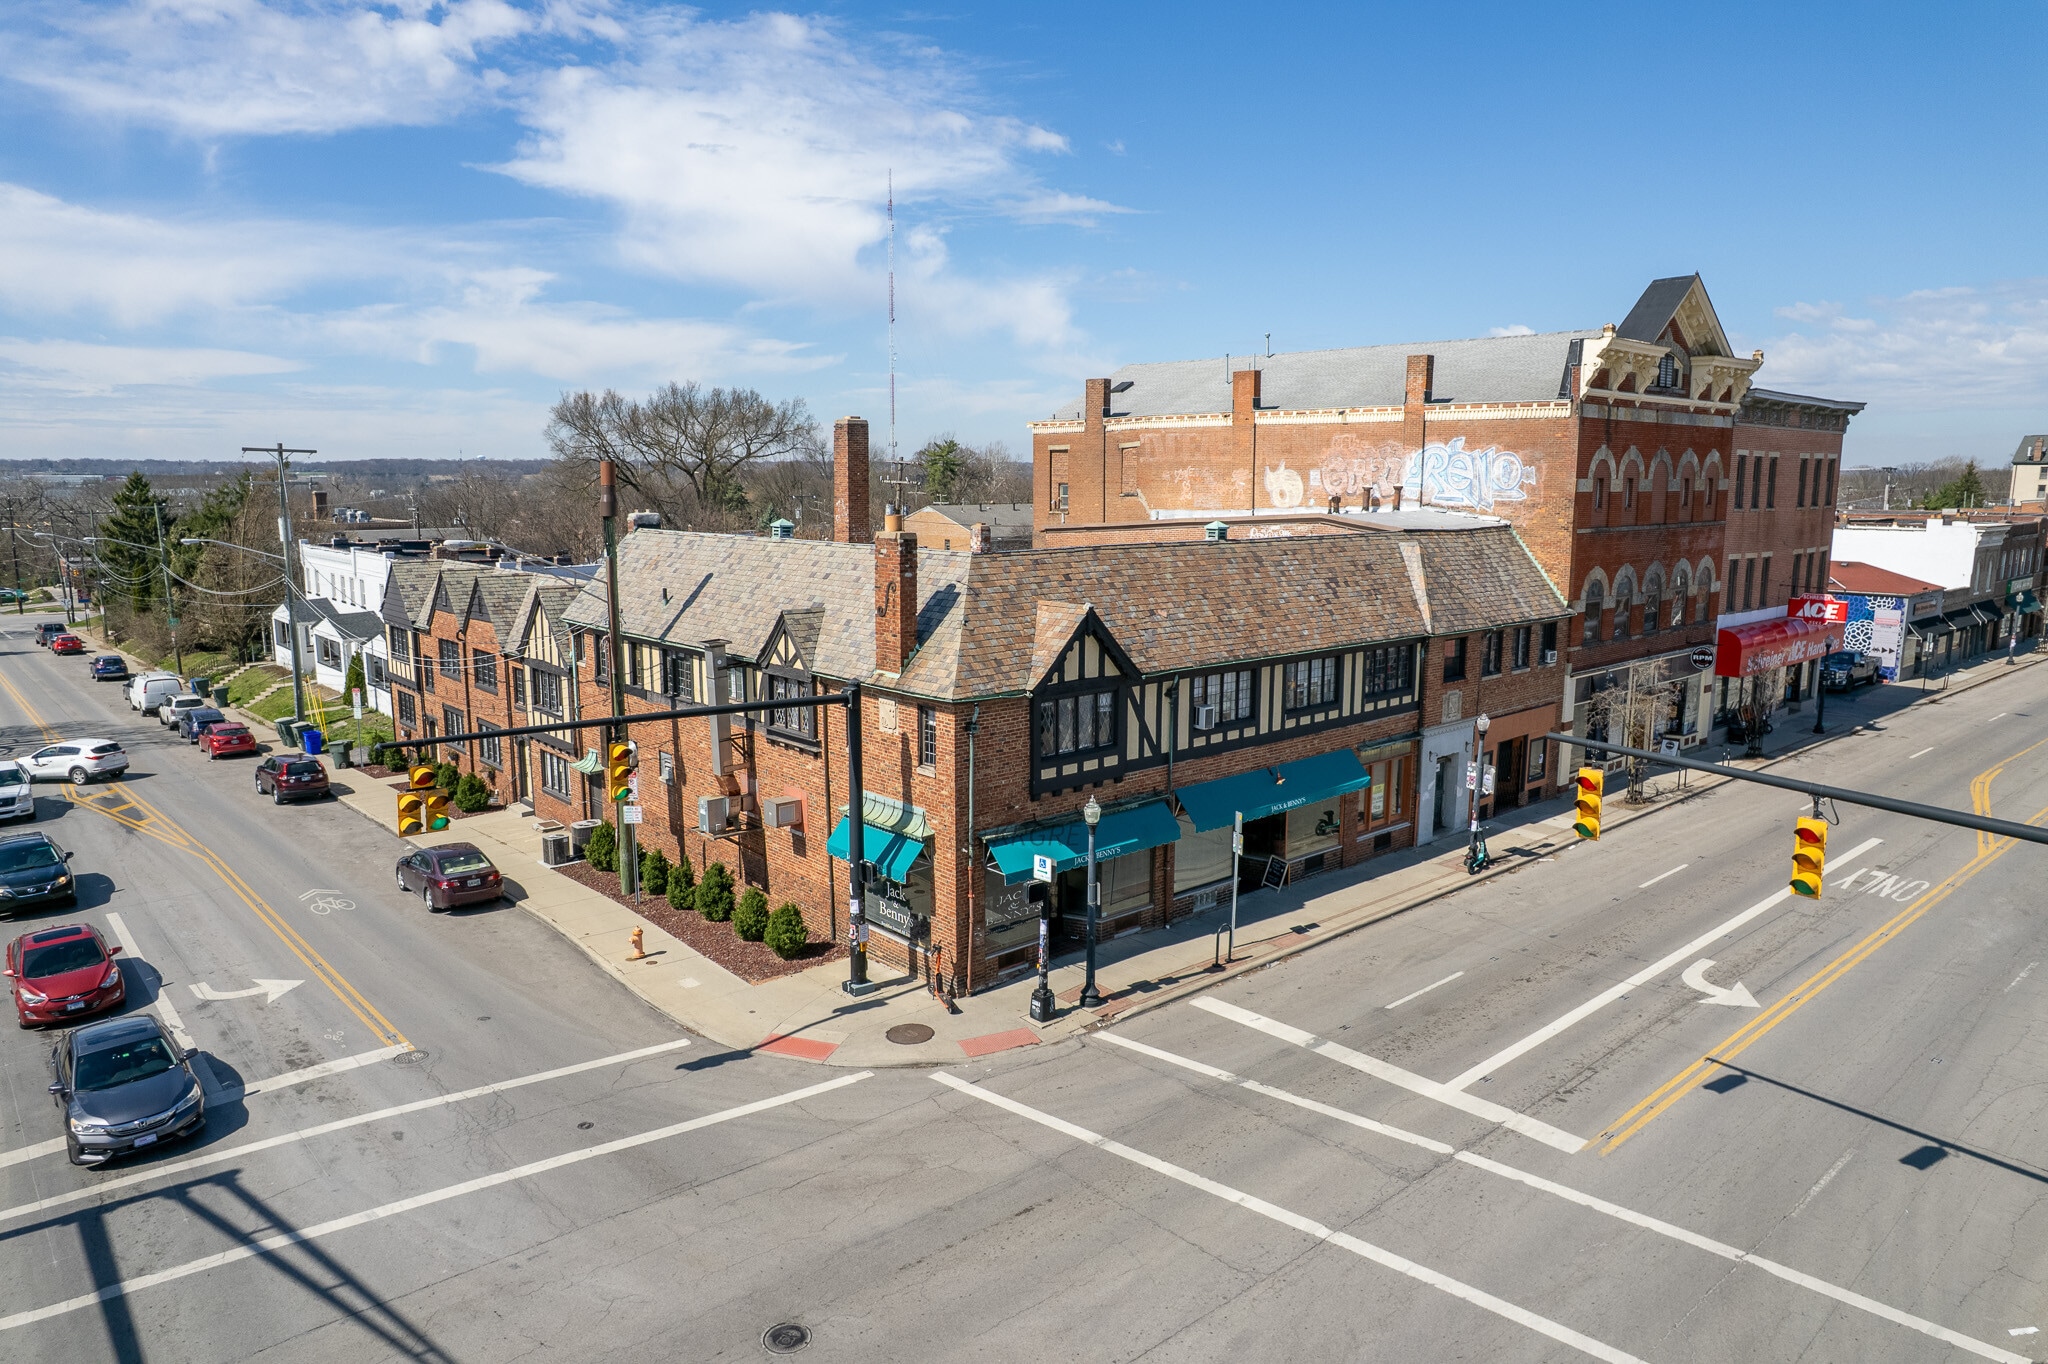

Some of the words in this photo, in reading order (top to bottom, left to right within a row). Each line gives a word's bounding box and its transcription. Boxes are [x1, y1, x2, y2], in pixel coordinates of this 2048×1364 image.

[1796, 600, 1839, 619] ACE
[1788, 640, 1806, 662] ACE
[1096, 846, 1121, 859] BENNY'S
[886, 881, 906, 902] Jack
[1828, 867, 1930, 902] ONLY
[892, 901, 900, 909] &
[996, 890, 1022, 907] JAC
[879, 900, 914, 929] Benny's
